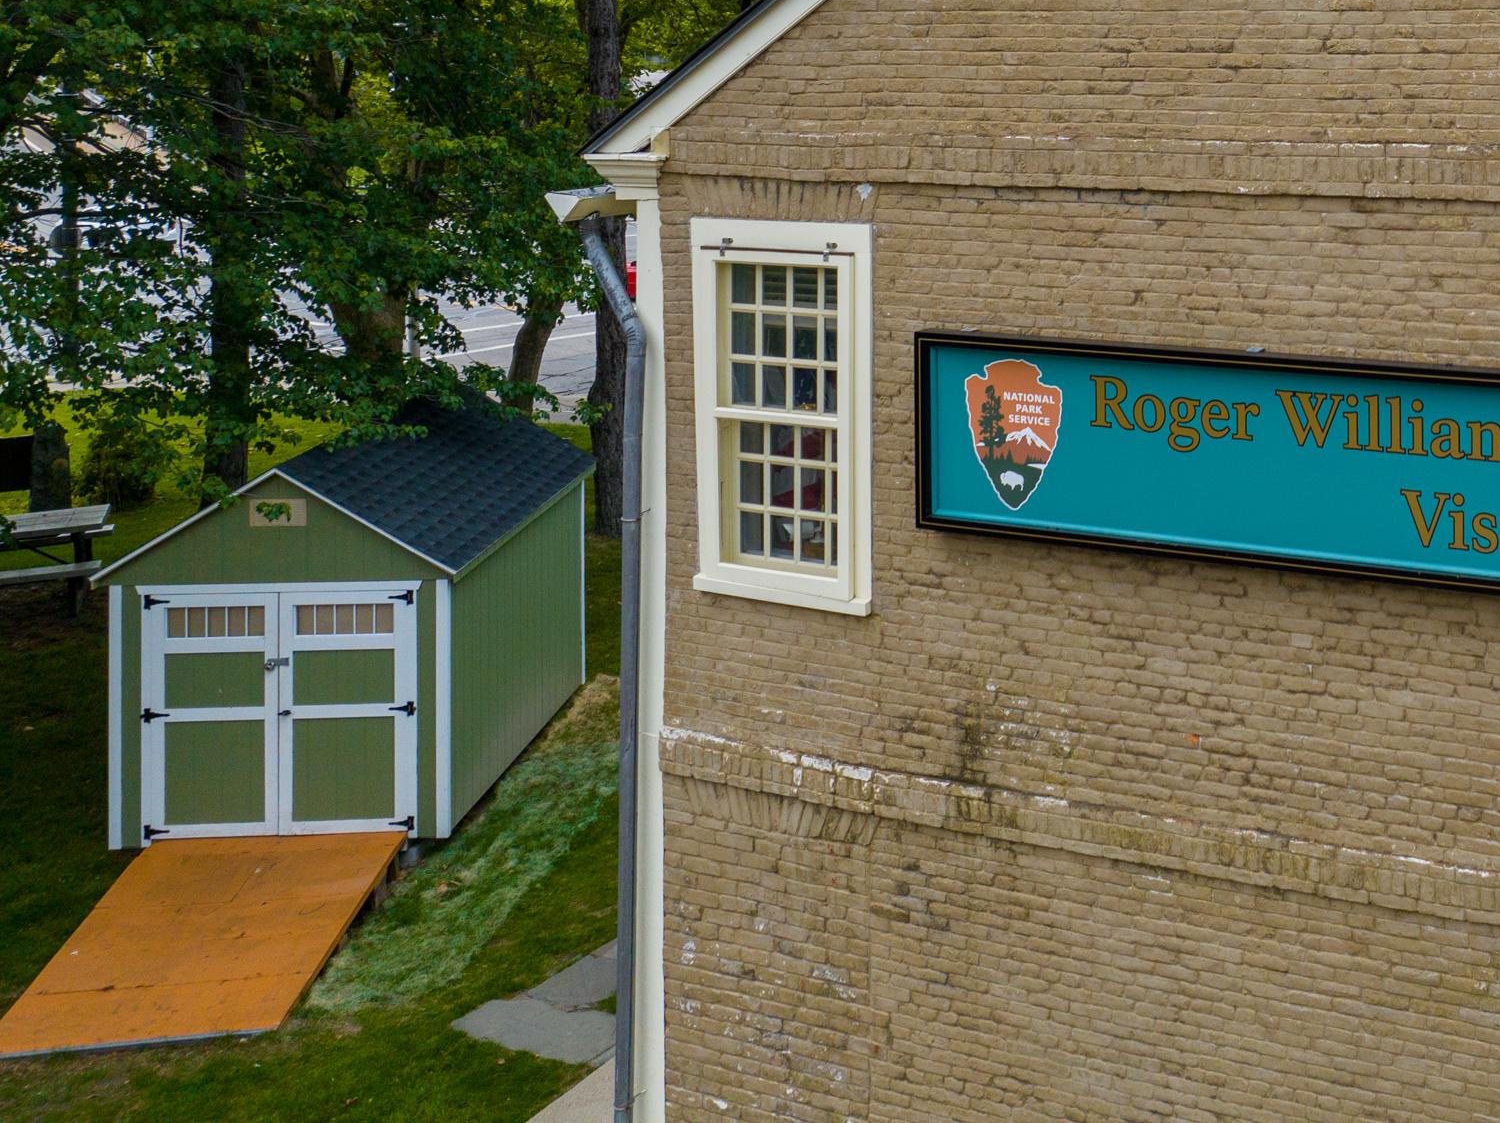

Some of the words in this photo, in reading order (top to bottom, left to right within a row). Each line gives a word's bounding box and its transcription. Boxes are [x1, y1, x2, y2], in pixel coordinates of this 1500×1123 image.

[1003, 391, 1056, 405] NATIONAL
[1015, 404, 1042, 415] PARK
[1089, 373, 1262, 453] Roger
[1008, 414, 1051, 426] SERVICE
